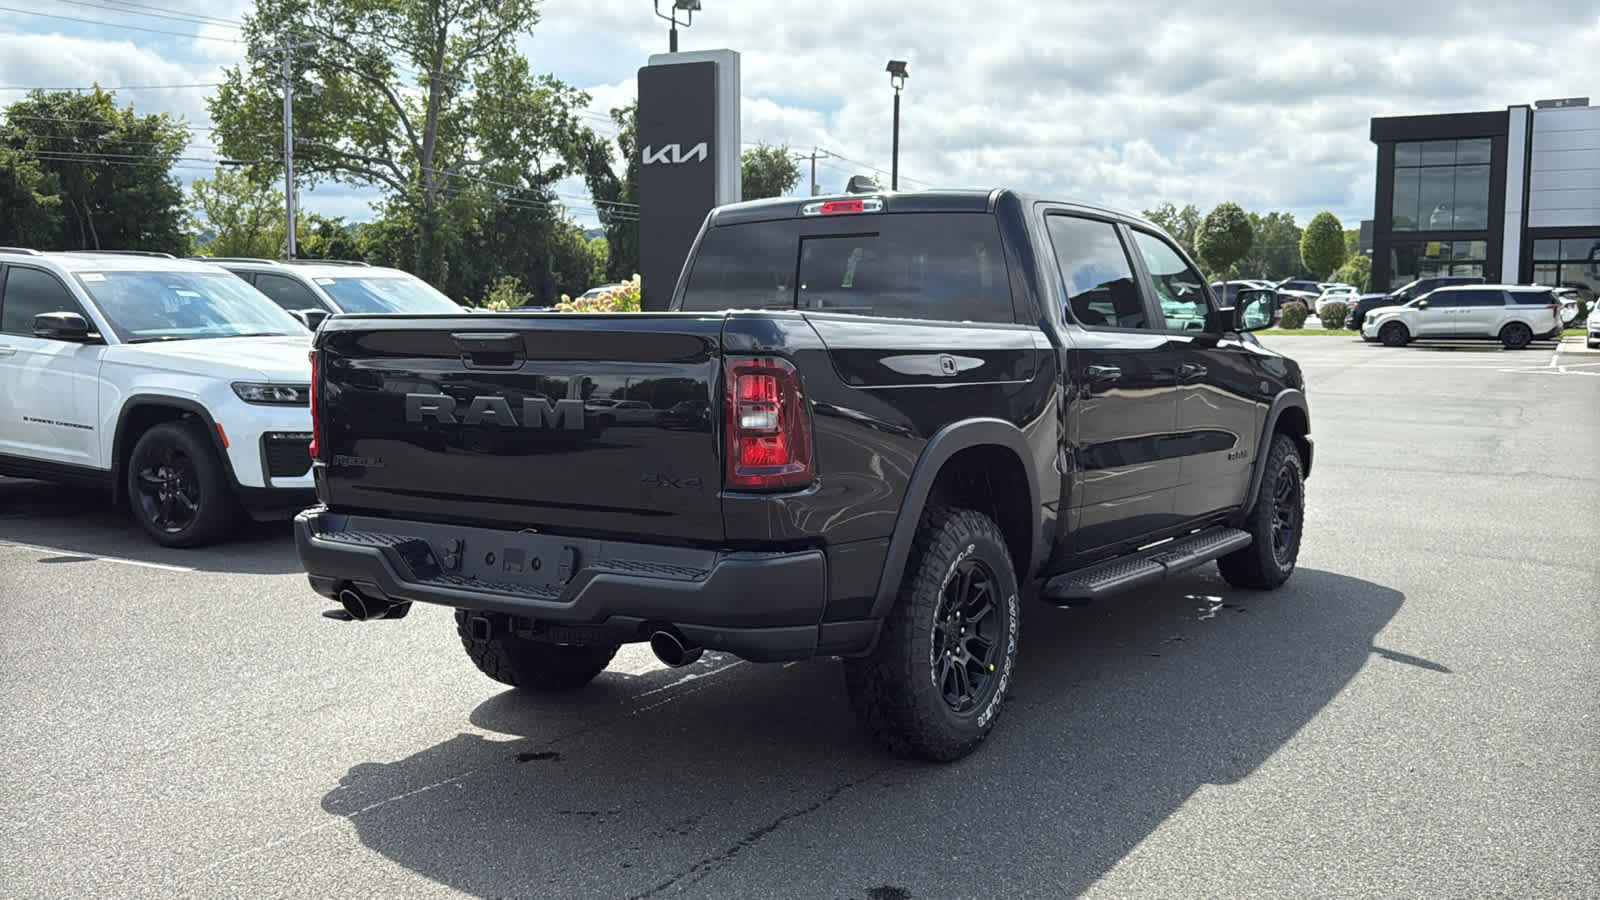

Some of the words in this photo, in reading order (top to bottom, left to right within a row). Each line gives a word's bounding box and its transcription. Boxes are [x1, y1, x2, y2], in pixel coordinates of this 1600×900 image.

[642, 142, 708, 164] KIA
[405, 392, 585, 430] RAM
[977, 594, 1017, 727] WRANGLER
